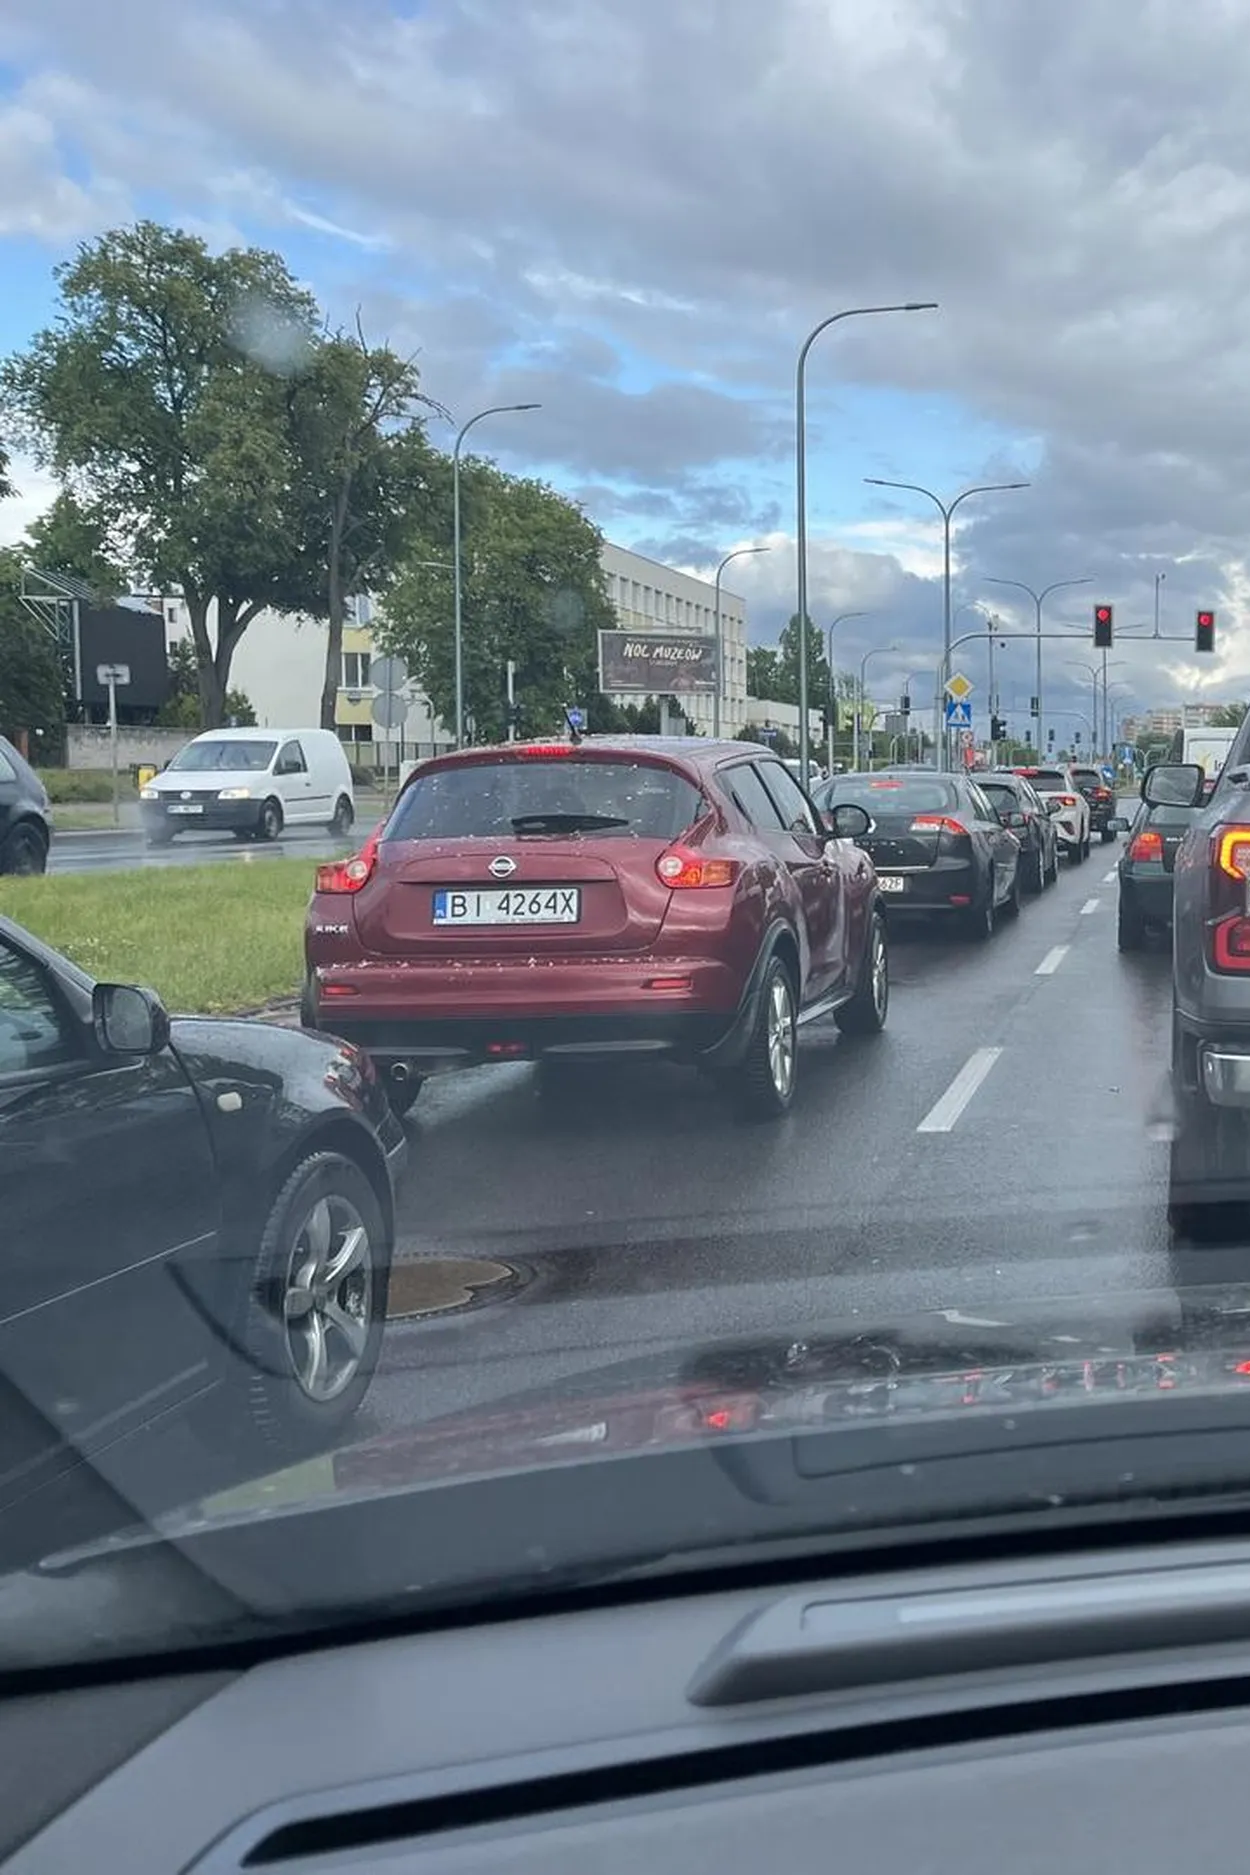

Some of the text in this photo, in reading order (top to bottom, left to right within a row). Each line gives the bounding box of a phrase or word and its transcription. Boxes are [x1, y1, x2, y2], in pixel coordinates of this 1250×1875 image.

[623, 643, 649, 658] NOC
[451, 890, 574, 918] BI 4264X
